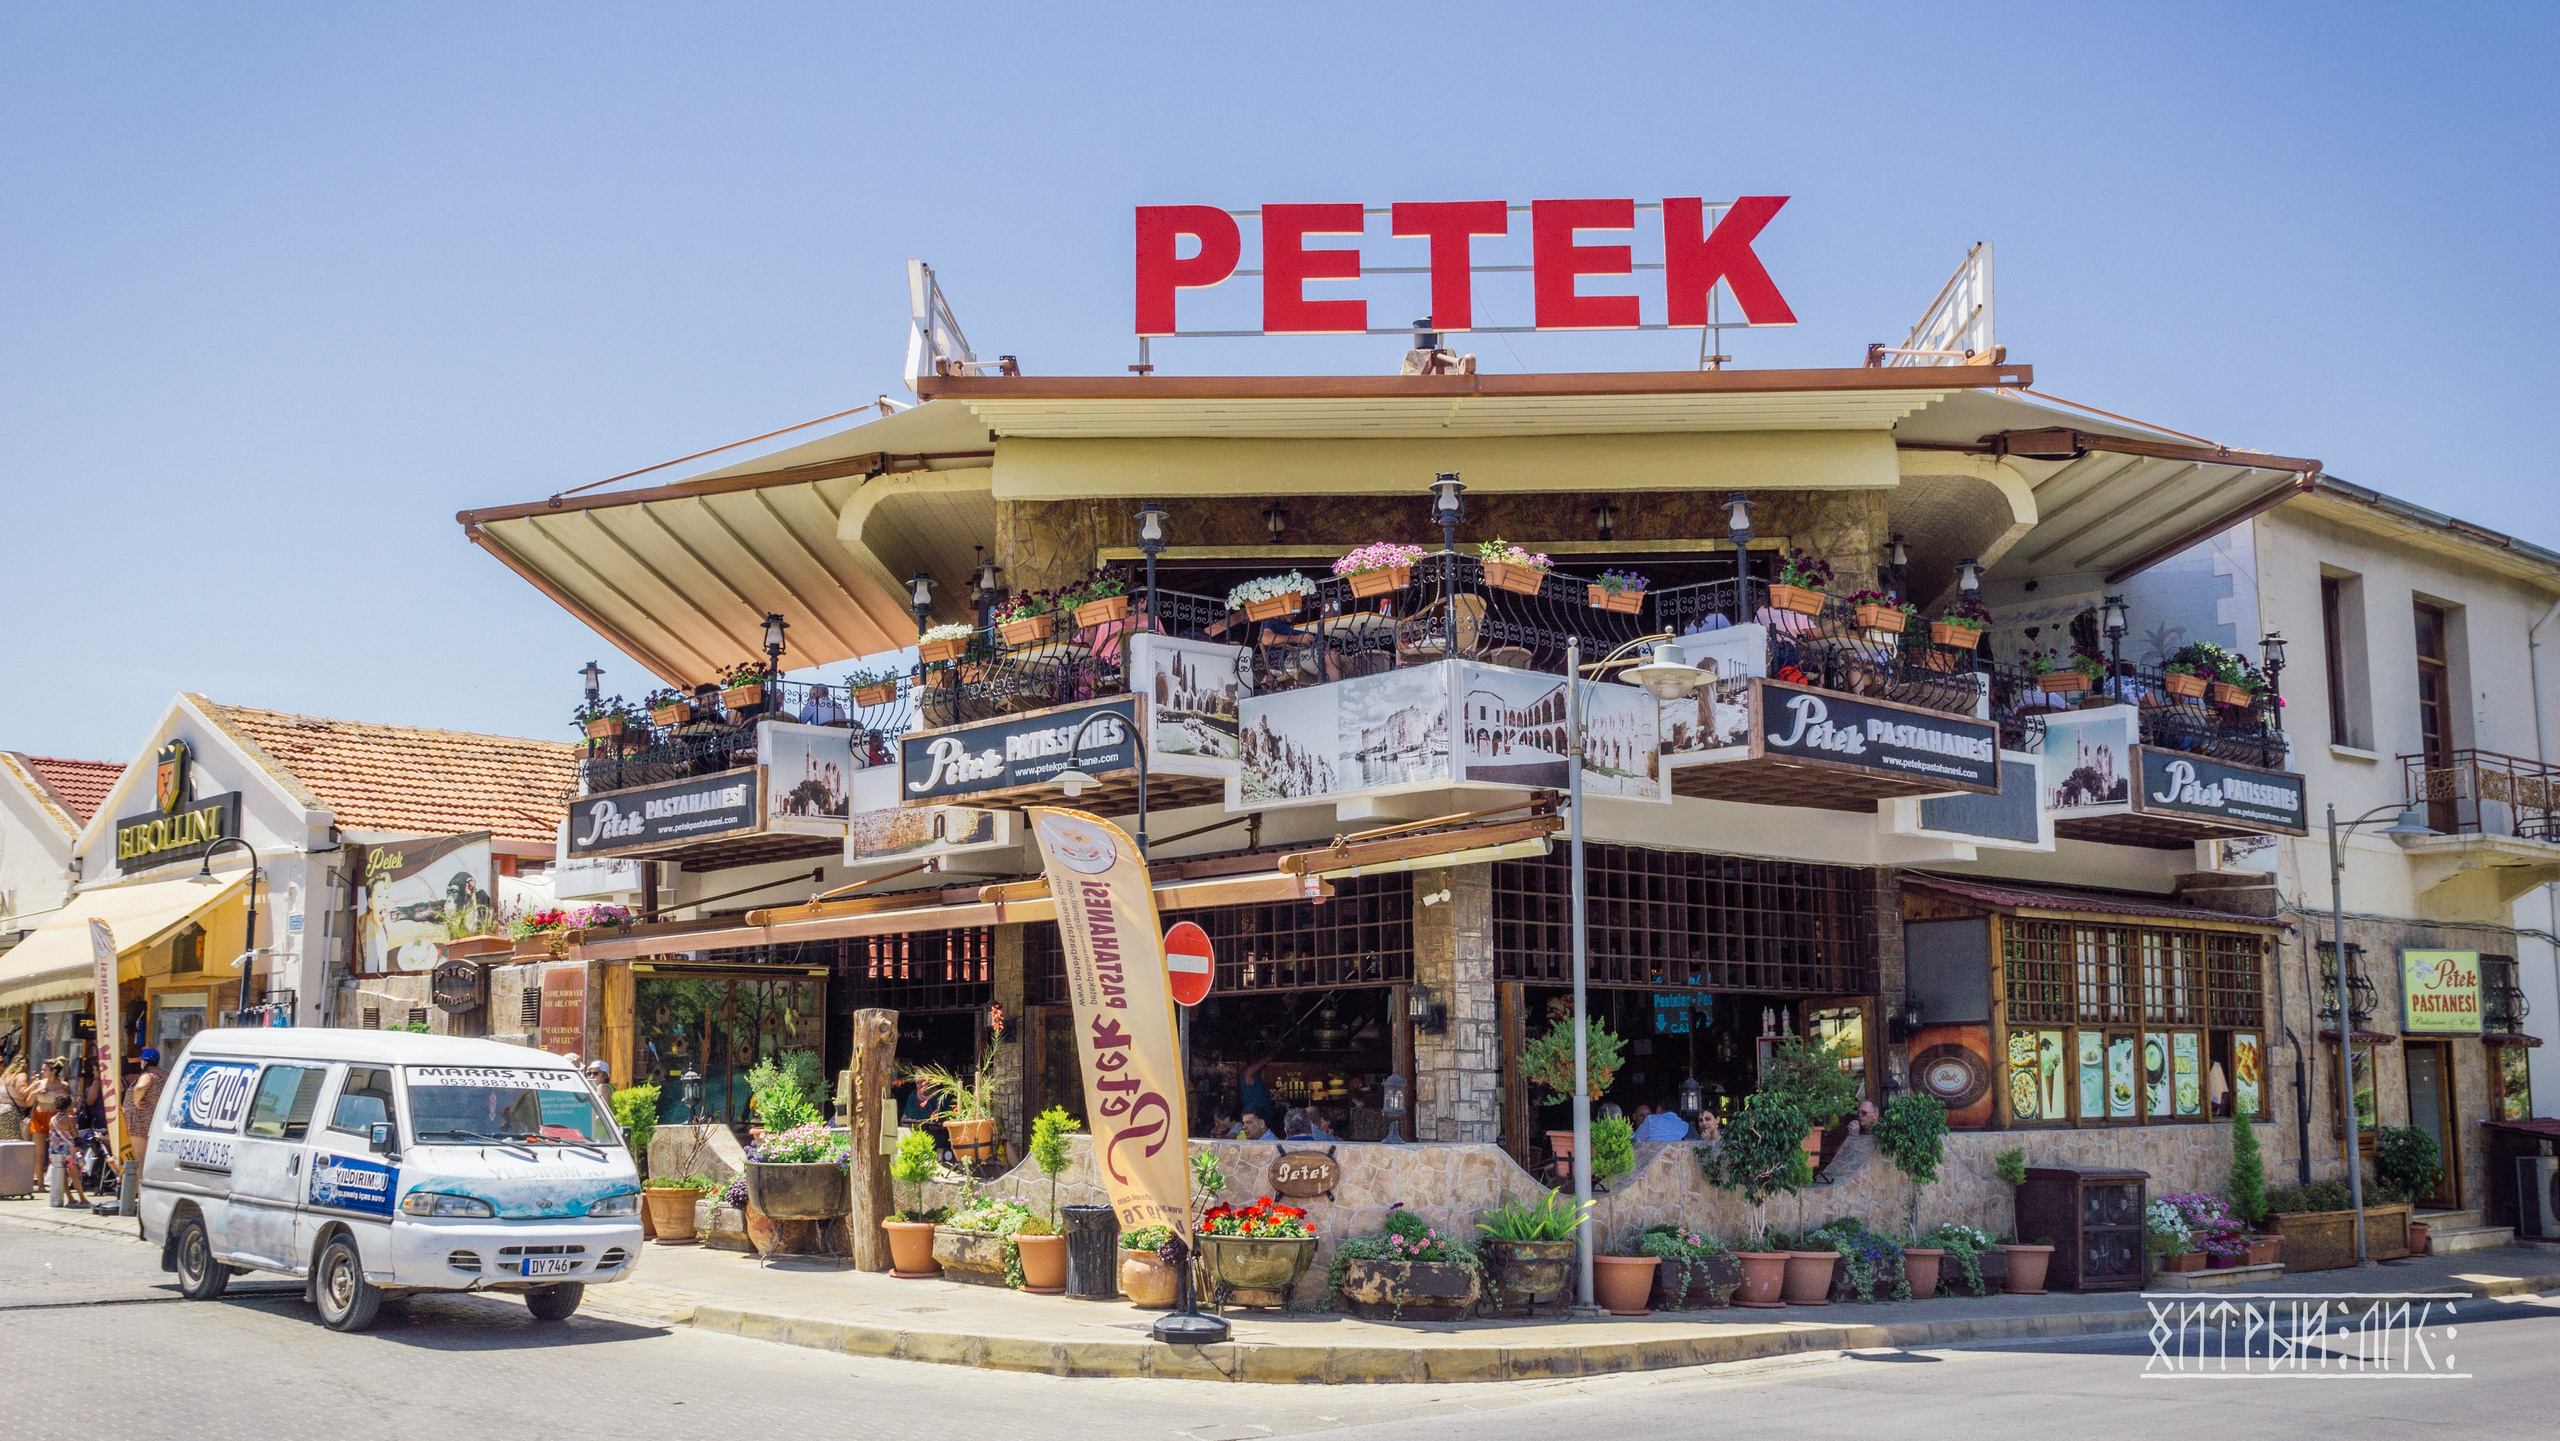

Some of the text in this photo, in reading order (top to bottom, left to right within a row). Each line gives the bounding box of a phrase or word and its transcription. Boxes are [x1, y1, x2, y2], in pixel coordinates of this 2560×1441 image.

[1135, 195, 1798, 337] PETEK
[1767, 694, 1994, 763] Petek PASTAHANESİ
[908, 717, 1126, 793] Petek PATISSERIES
[1014, 752, 1119, 778] www.petekpahane.com
[1882, 755, 1978, 779] www.petekpastahanesi.com
[2153, 760, 2299, 812] Petek PATISSERIES
[577, 783, 747, 846] Petek PASTAHANESİ
[657, 815, 738, 834] www.petekpastahanesi.com
[117, 805, 222, 861] BIBOLLINI
[365, 845, 404, 878] Petek
[2424, 958, 2478, 990] Petek
[2412, 990, 2477, 1013] PASTANESİ
[418, 1068, 571, 1082] MARAŞ TÜP
[440, 1078, 551, 1090] 0533 883 10 19
[179, 1138, 197, 1161] 0548
[194, 1140, 211, 1163] 848
[1276, 1162, 1330, 1183] Petek
[532, 1259, 568, 1273] DY 746
